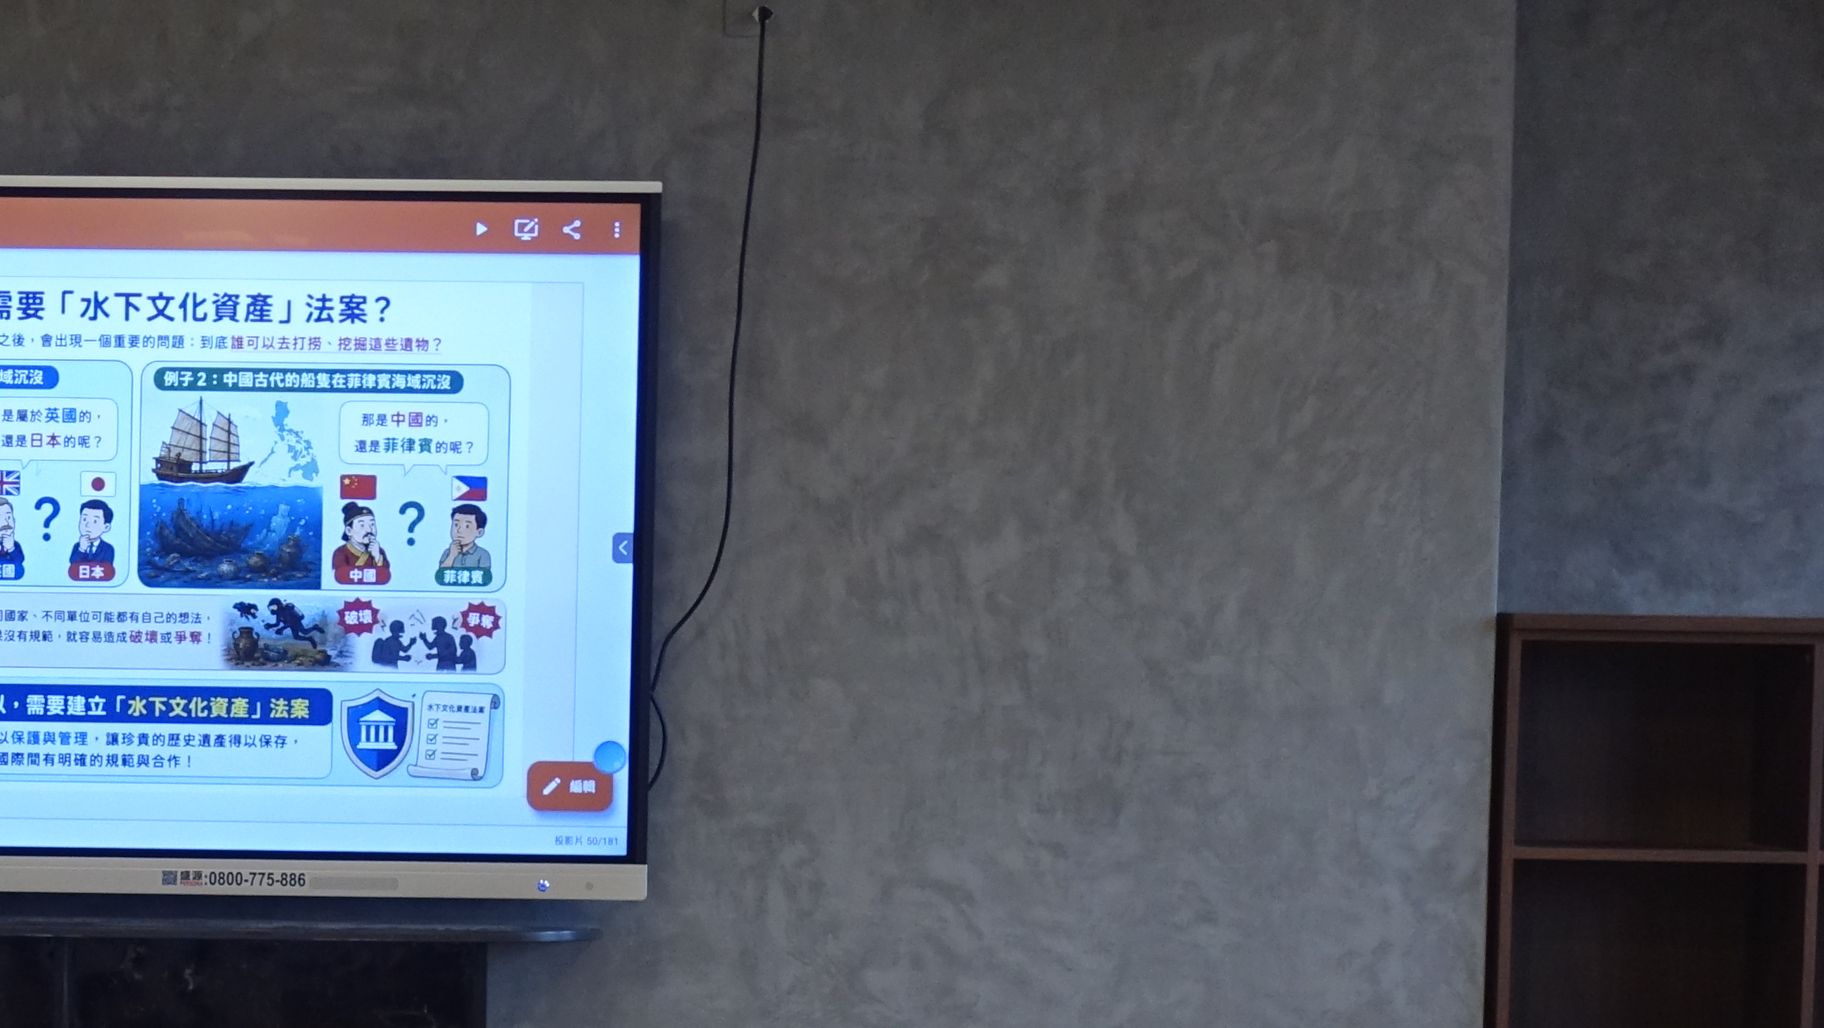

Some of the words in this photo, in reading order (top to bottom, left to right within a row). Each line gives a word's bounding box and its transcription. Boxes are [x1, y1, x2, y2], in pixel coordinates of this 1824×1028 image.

[1, 406, 101, 423] 是屬於英國的，
[361, 411, 448, 428] 那是中國的，
[1, 432, 103, 449] 還是日本的呢？
[354, 437, 474, 454] 還是菲律賓的呢？
[79, 564, 105, 579] 日本
[349, 569, 377, 583] 中國
[443, 569, 484, 584] 菲律賓
[344, 610, 373, 625] 破壞
[466, 612, 495, 629] 爭奪
[426, 703, 485, 714] 水下文化資產法案
[569, 779, 596, 794] 編輯
[555, 835, 583, 846] 投影片
[587, 836, 619, 847] 50/181
